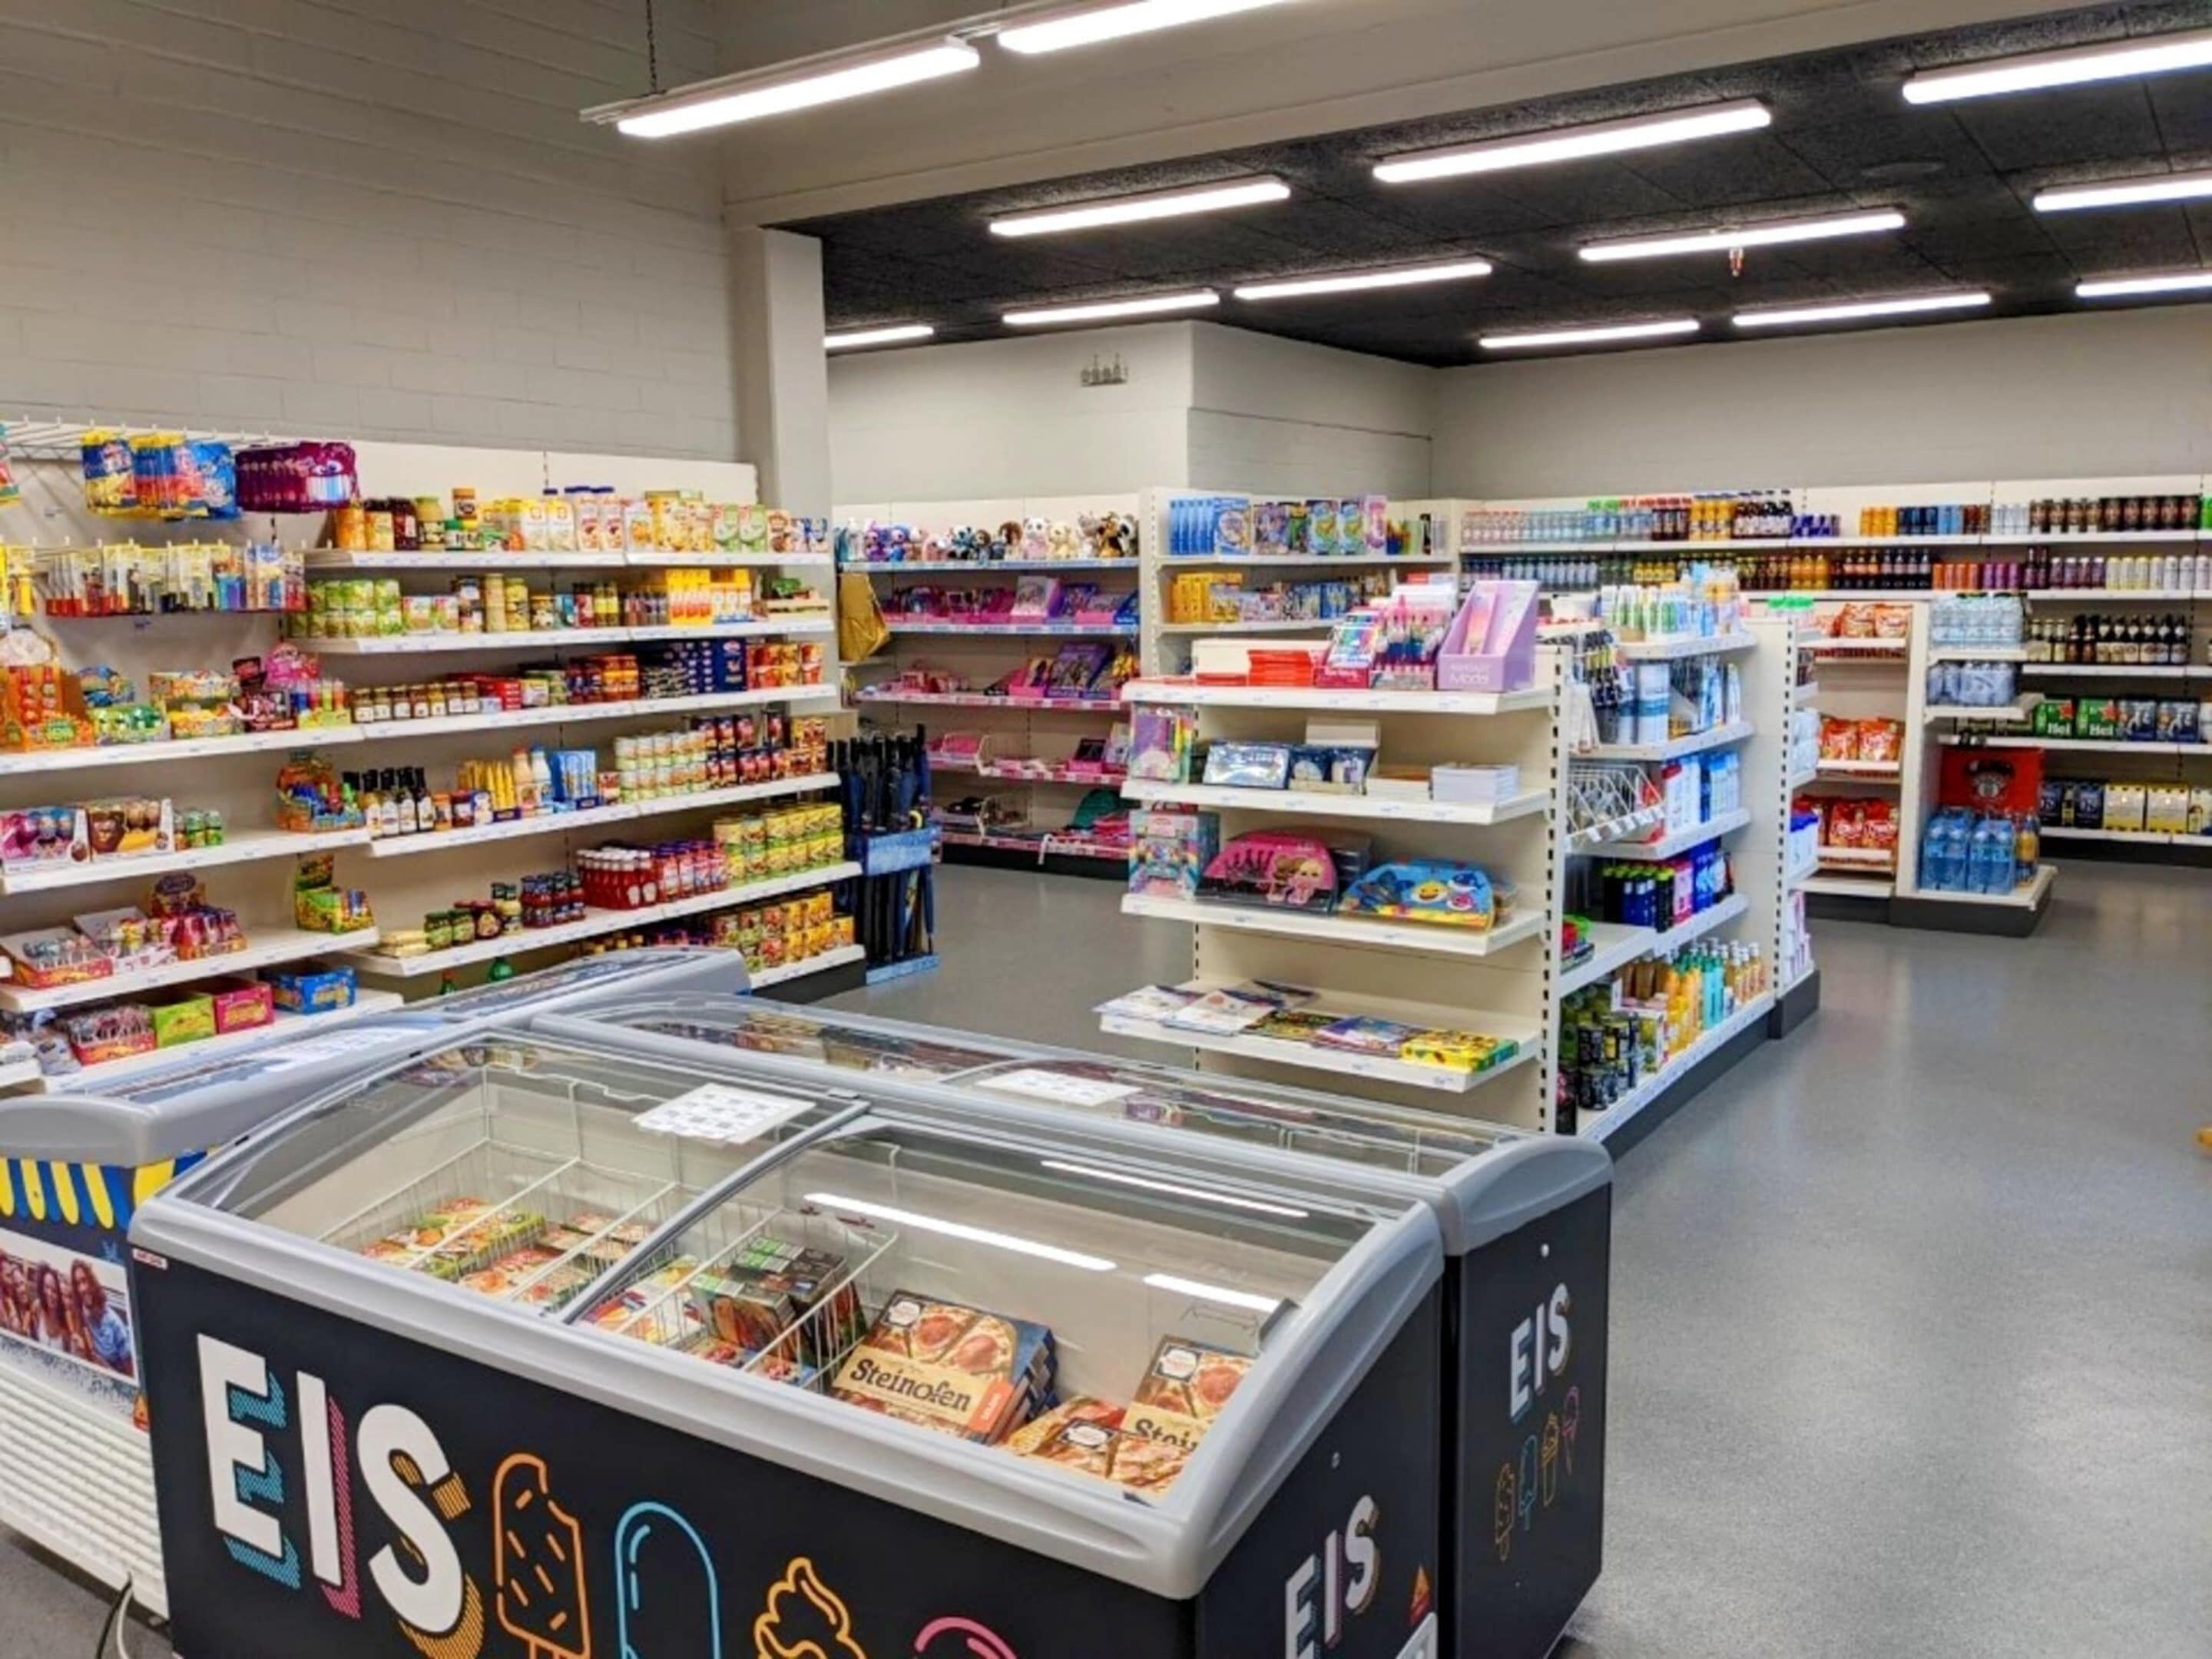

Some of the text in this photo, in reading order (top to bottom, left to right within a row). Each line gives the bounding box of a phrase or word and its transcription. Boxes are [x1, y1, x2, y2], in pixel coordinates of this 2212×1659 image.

[850, 1359, 972, 1412] Steinofen
[1510, 1282, 1570, 1419] EIS
[197, 1333, 469, 1637] EIS
[1135, 1418, 1199, 1452] Stei
[1286, 1495, 1378, 1659] EIS
